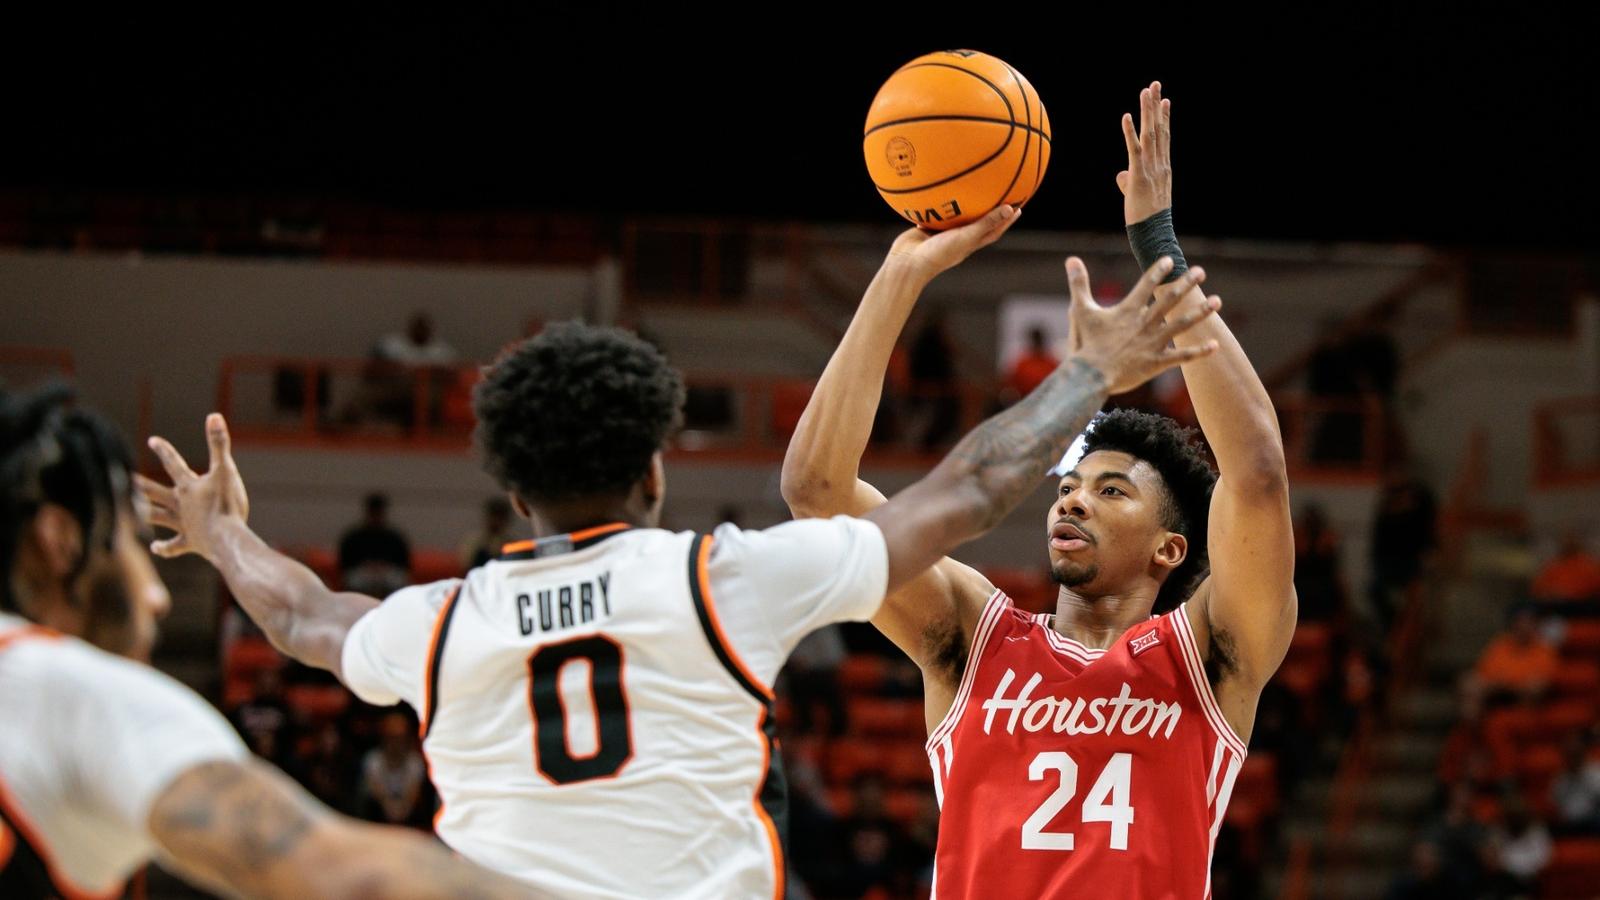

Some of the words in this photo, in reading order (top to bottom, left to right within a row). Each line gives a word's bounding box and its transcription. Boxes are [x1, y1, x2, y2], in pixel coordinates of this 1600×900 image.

[516, 571, 611, 636] CURRY
[526, 630, 636, 786] 0
[981, 667, 1182, 740] Houston
[1021, 751, 1134, 851] 24
